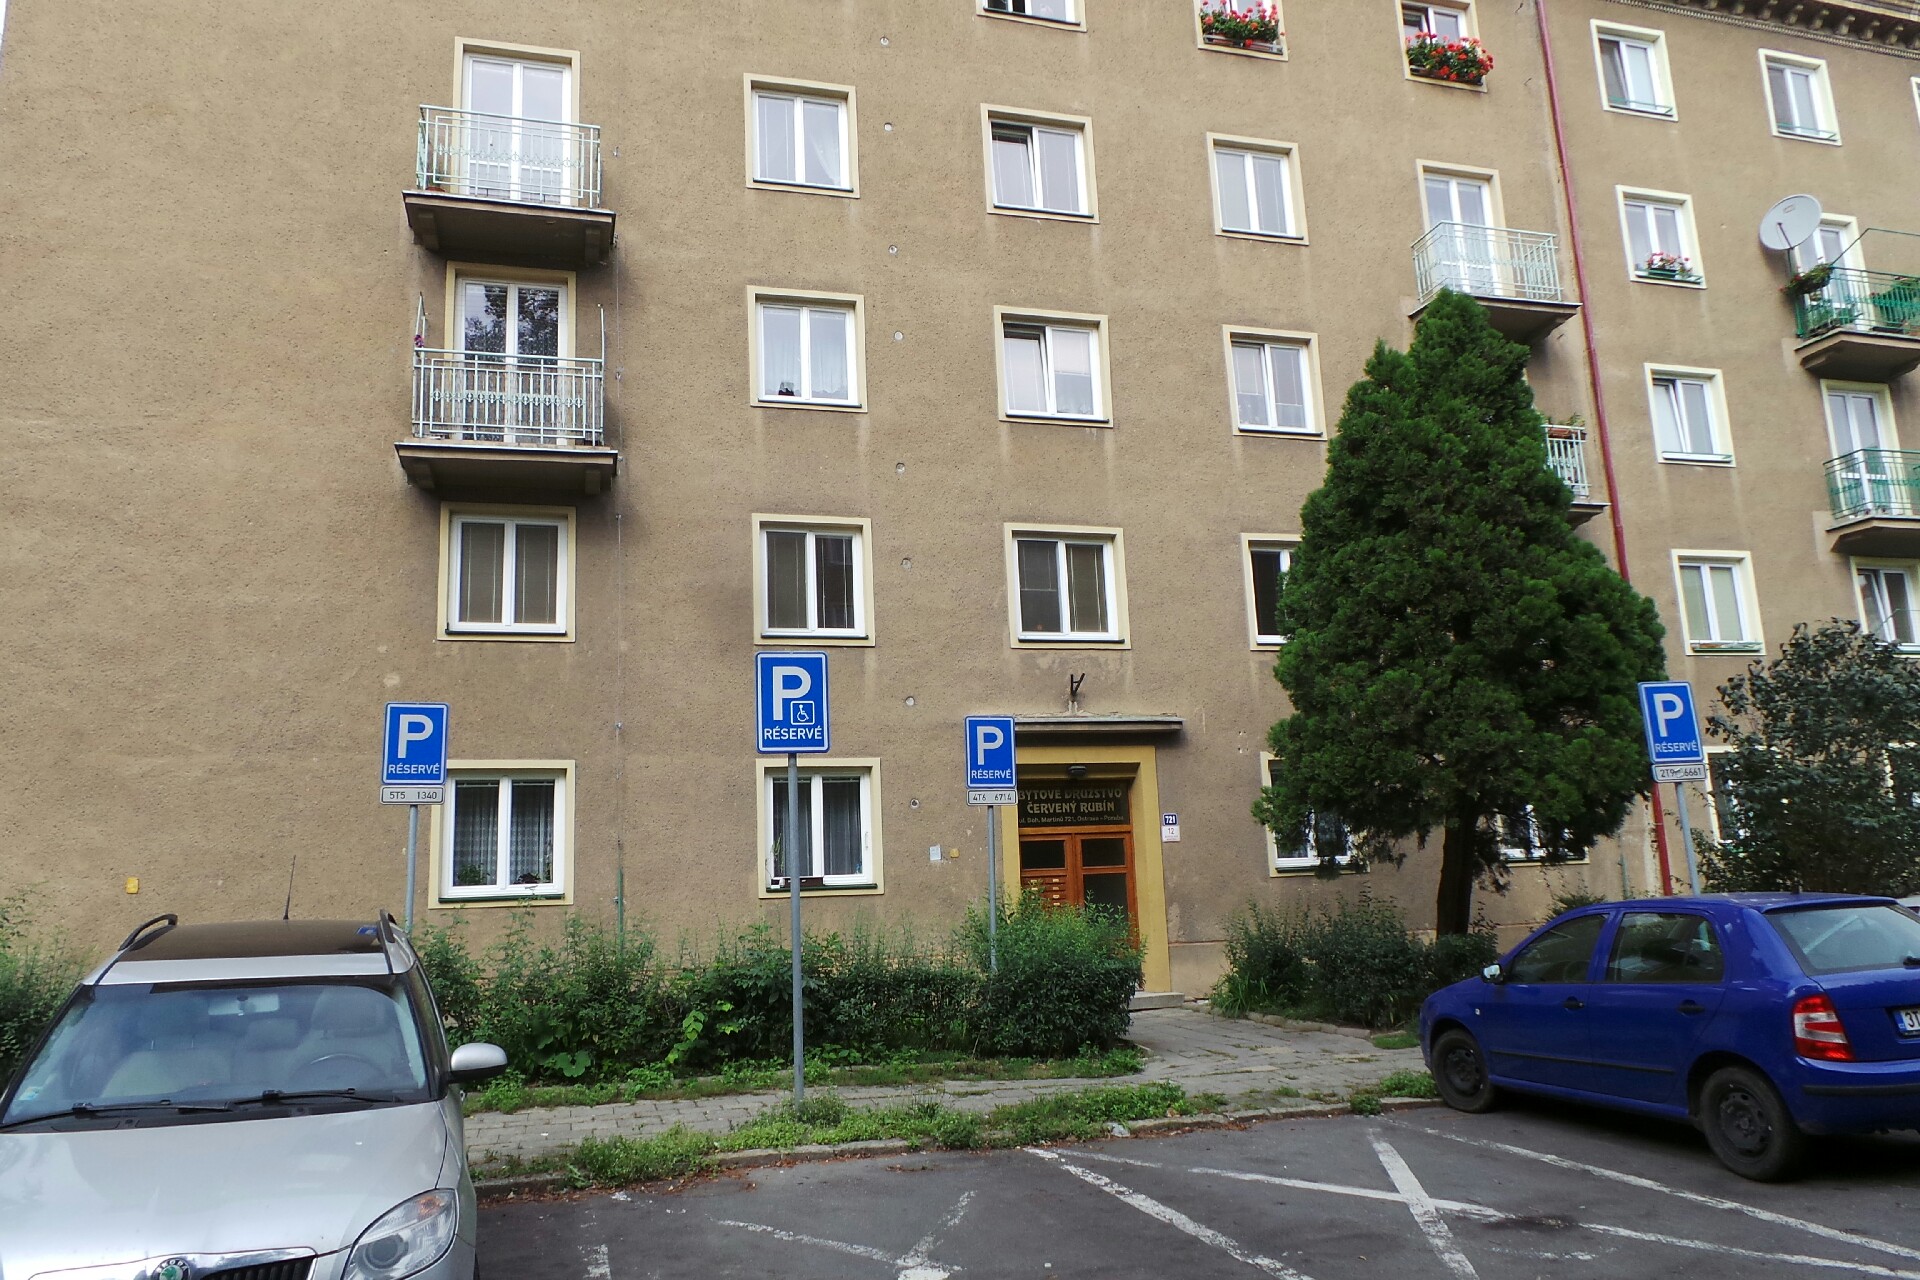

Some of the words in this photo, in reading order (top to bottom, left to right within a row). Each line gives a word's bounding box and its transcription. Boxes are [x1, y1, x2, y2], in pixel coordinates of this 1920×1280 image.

[772, 666, 812, 720] P
[1652, 693, 1684, 738] P
[397, 714, 434, 759] P
[763, 725, 823, 740] RÉSERVÉ
[976, 725, 1004, 765] P
[1655, 740, 1698, 752] RÉSERVÉ
[388, 763, 440, 774] RÉSERVÉ
[971, 768, 1012, 779] RÉSERVÉ
[389, 791, 406, 800] 5T5
[417, 791, 438, 800] 1340
[972, 793, 987, 801] 4T6
[1026, 801, 1077, 814] ČERVENÝ
[1080, 800, 1115, 813] RUBÍN
[1165, 815, 1176, 824] 721
[1168, 827, 1175, 835] 12
